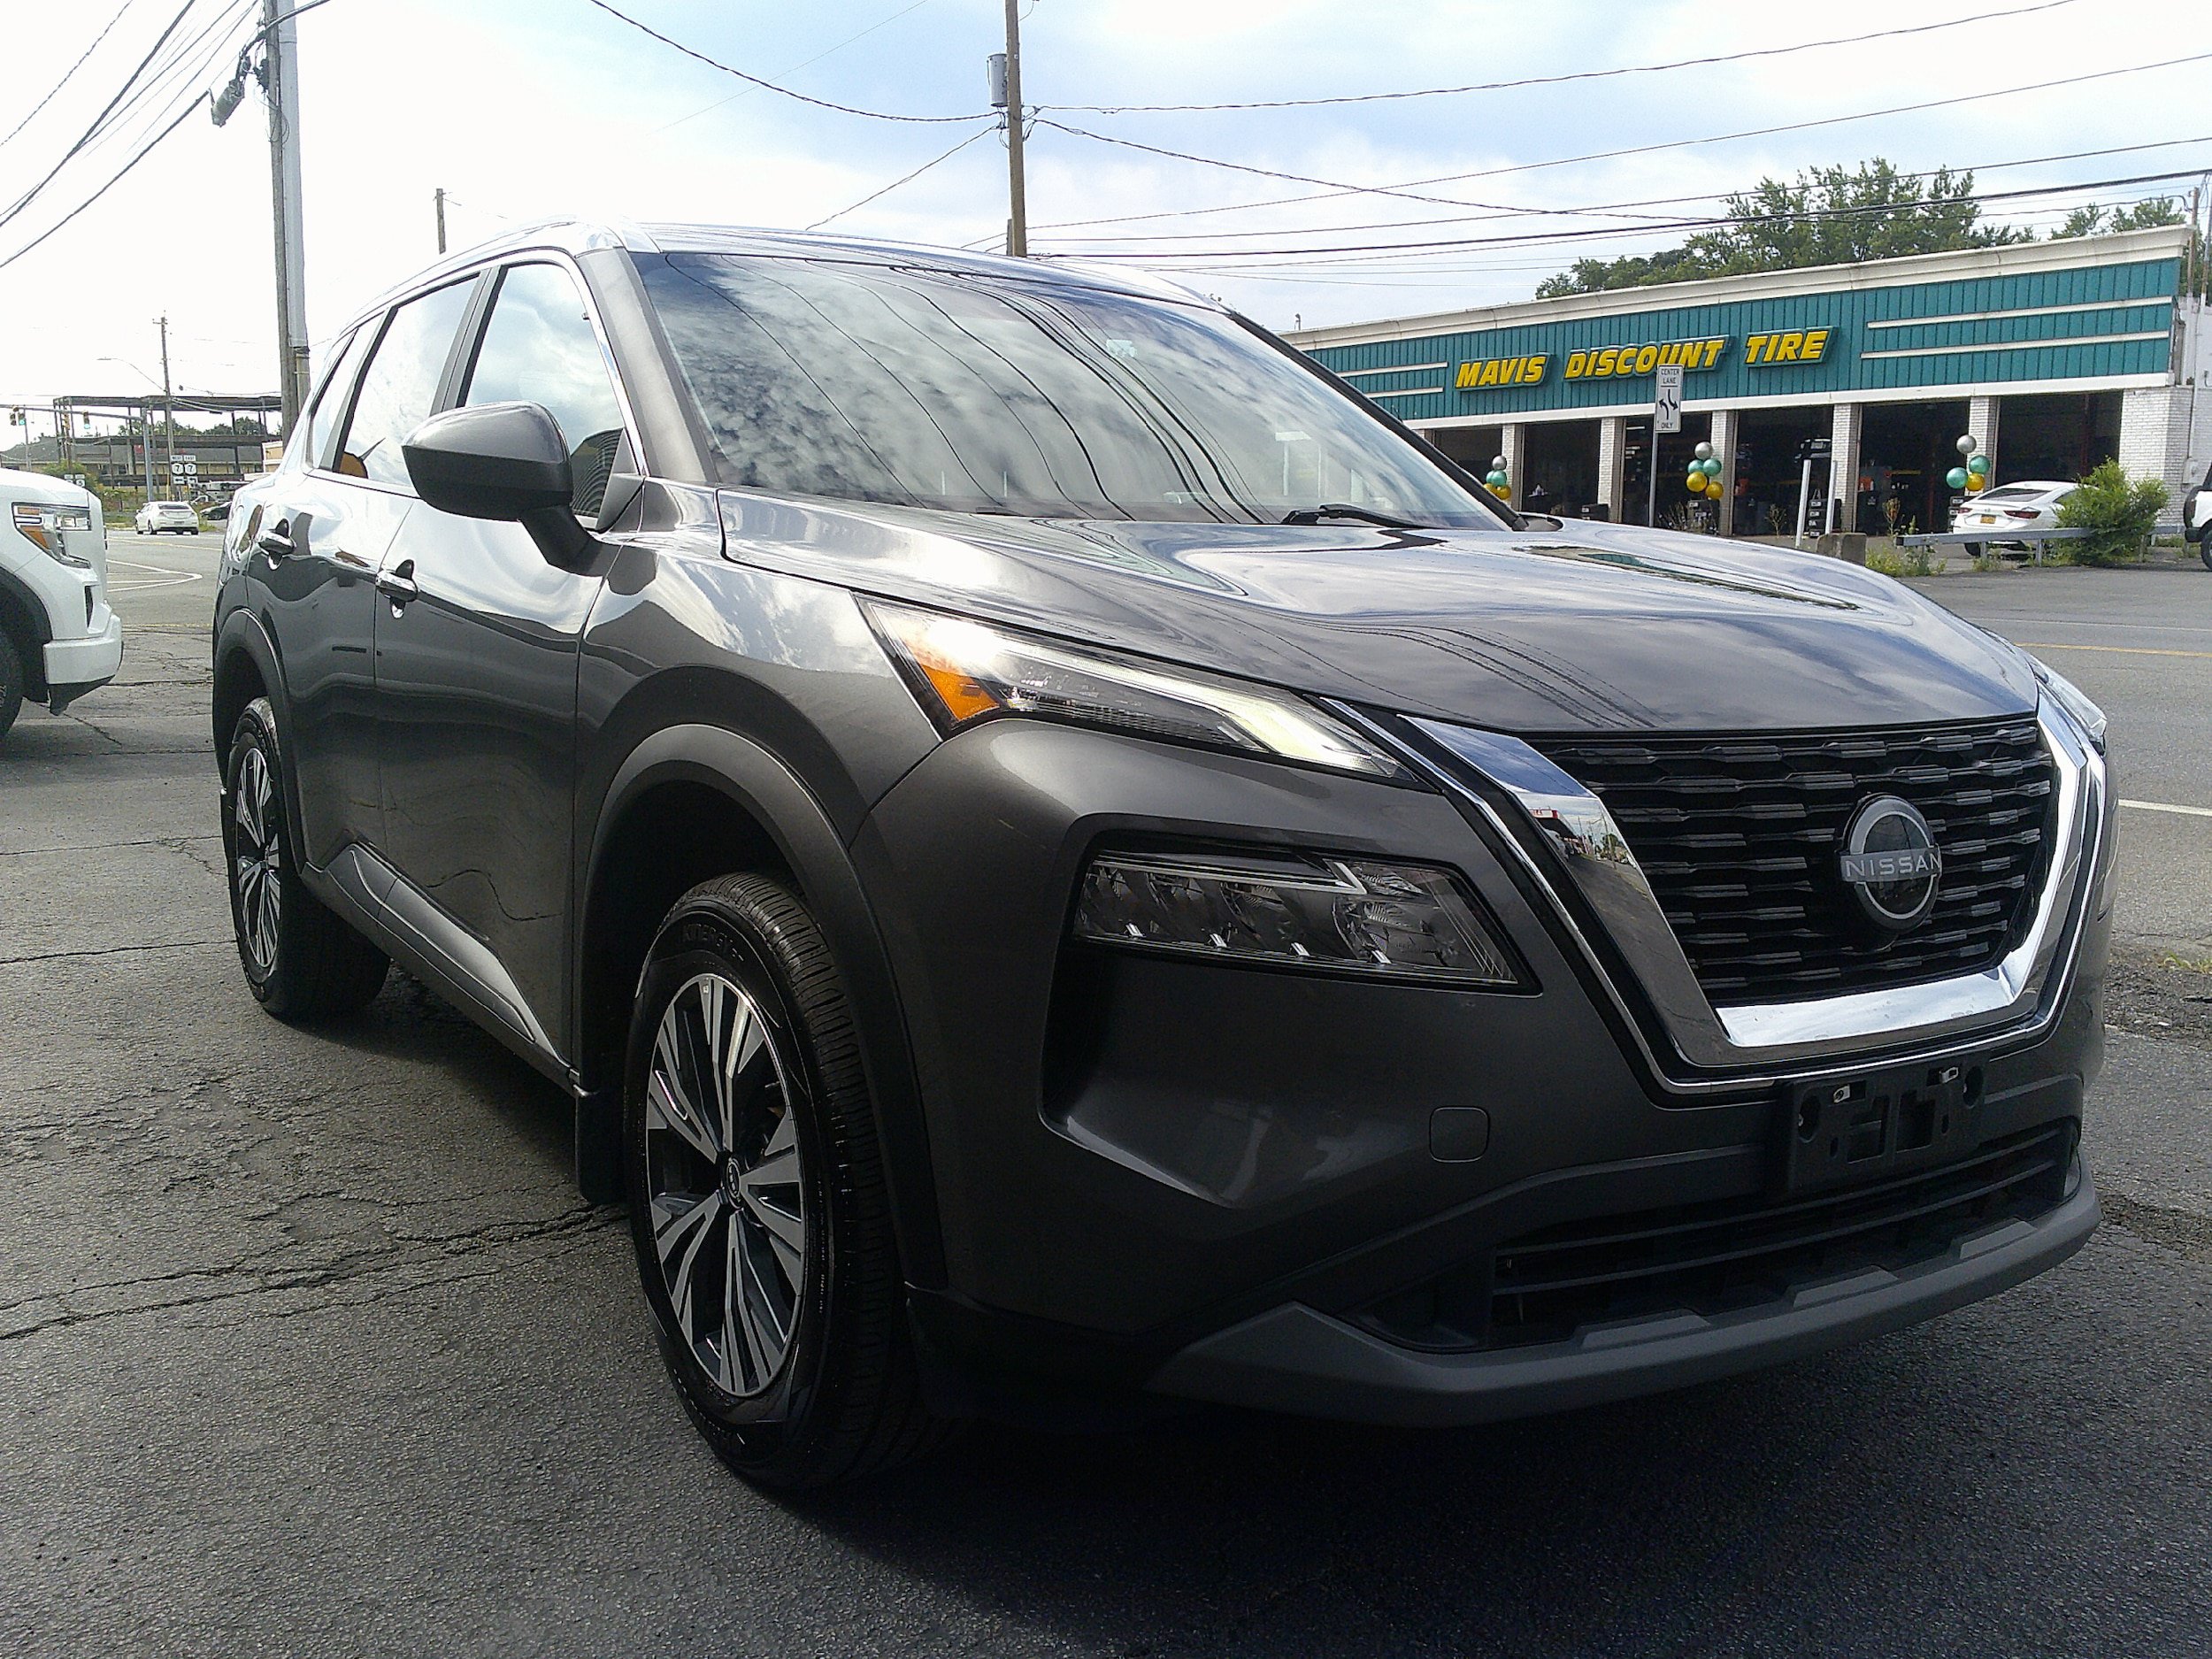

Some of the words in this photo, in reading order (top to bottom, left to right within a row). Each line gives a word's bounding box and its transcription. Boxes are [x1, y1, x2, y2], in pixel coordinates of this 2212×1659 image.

[1455, 357, 1547, 388] MAVIS
[1565, 340, 1725, 378] DISCOUNT
[1746, 331, 1829, 363] TIRE
[1846, 853, 1941, 877] NISSAN
